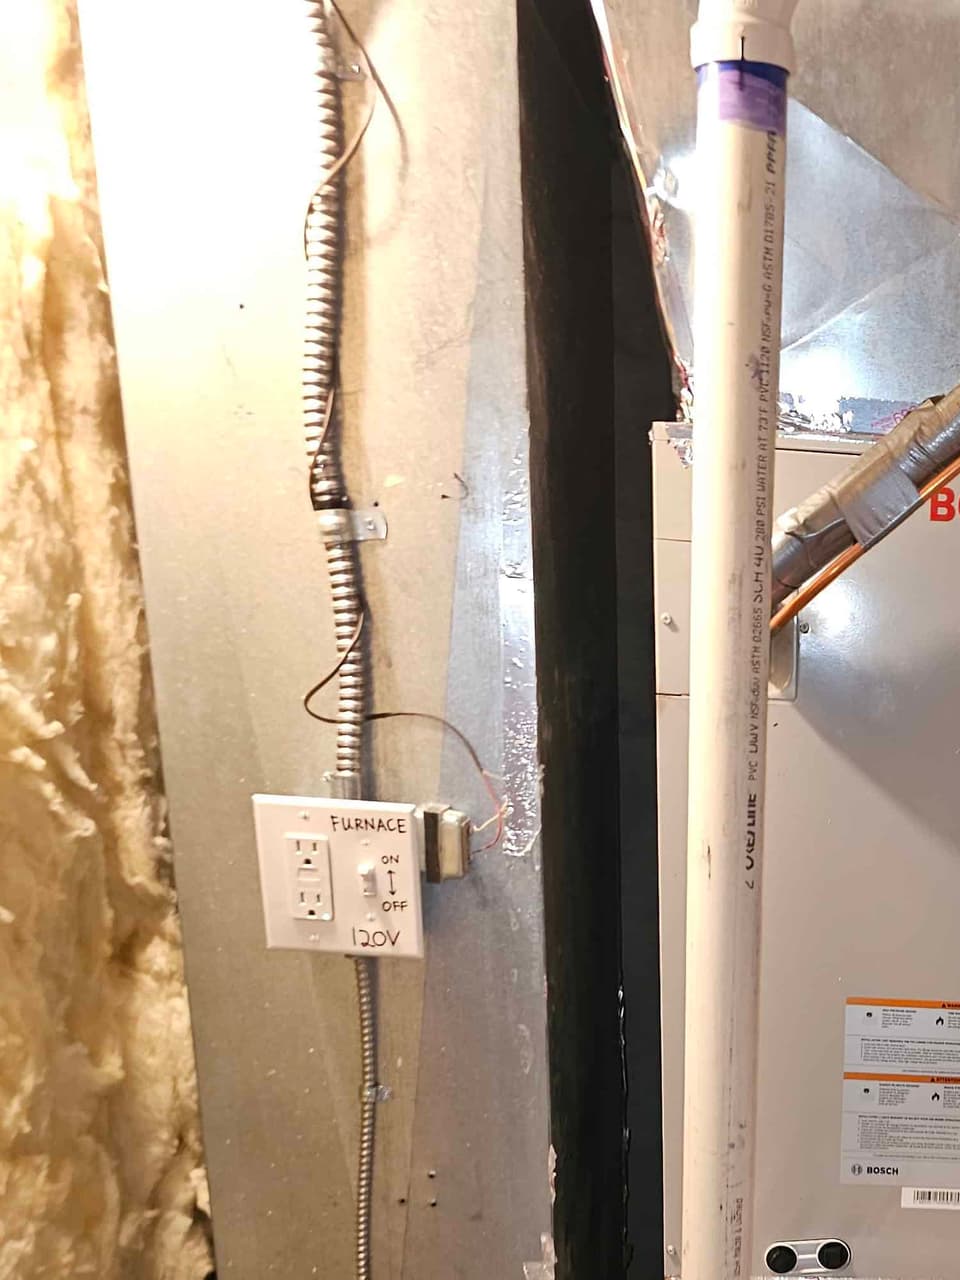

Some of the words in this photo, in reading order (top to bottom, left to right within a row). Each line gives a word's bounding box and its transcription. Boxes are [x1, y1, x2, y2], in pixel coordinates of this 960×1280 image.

[758, 436, 769, 451] AT
[757, 454, 768, 492] WATER
[756, 495, 767, 517] PSI
[330, 815, 407, 834] FURNACE
[381, 854, 399, 865] ON
[382, 900, 408, 912] OFF
[352, 925, 400, 948] 120V
[866, 1166, 899, 1176] BOSCH
